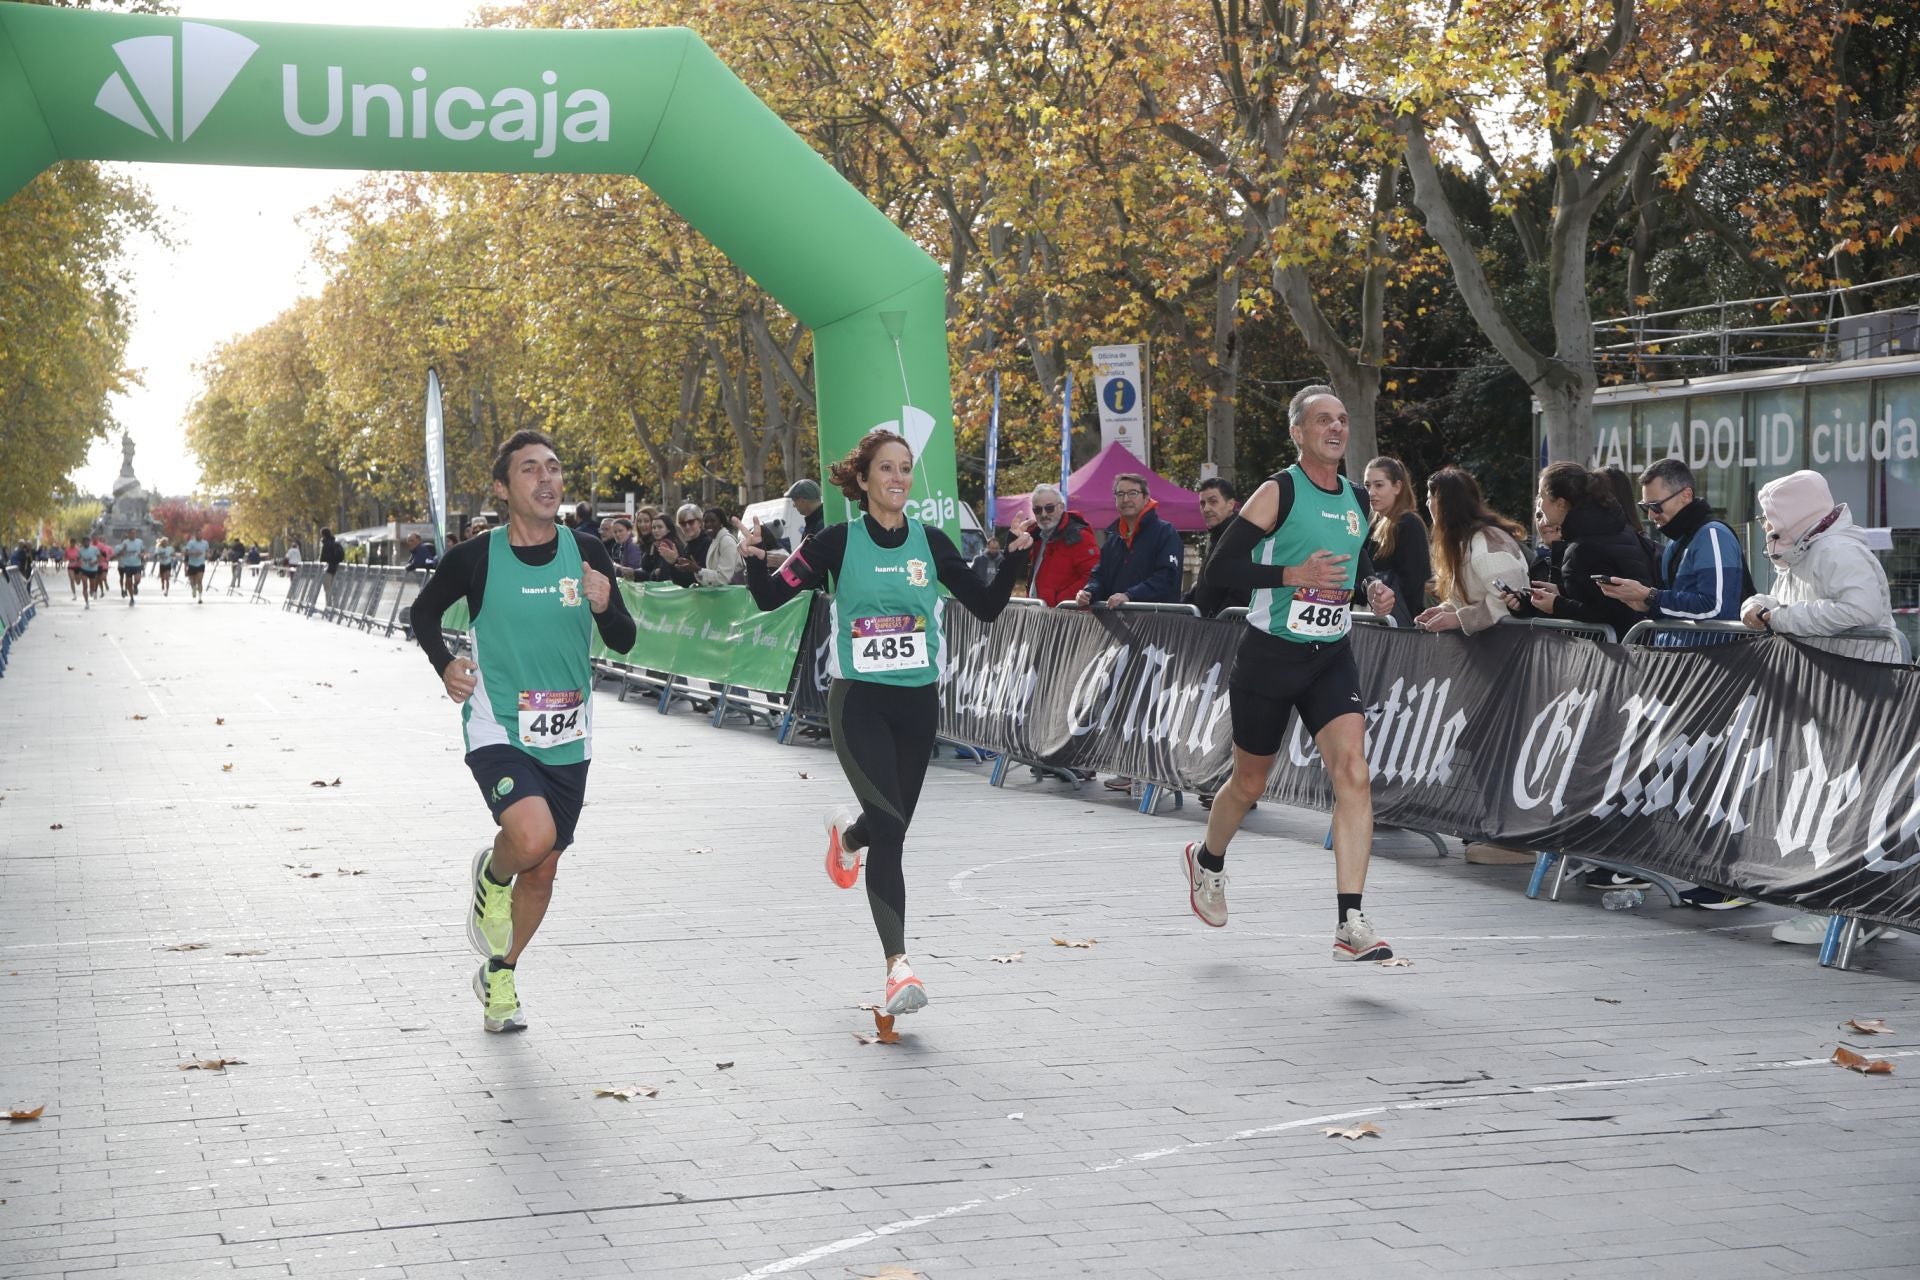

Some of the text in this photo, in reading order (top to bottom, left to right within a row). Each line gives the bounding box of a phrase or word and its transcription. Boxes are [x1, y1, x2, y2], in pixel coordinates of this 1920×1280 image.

[282, 63, 611, 158] Unicaja
[1098, 352, 1118, 360] Oficina
[1591, 412, 1795, 474] VALLADOLID
[875, 565, 898, 573] luanvi
[521, 586, 548, 594] luanvi
[1298, 605, 1344, 627] 486
[863, 635, 915, 660] 485
[530, 709, 579, 737] 484
[1590, 690, 1773, 834] Norte
[1774, 717, 1862, 870] de
